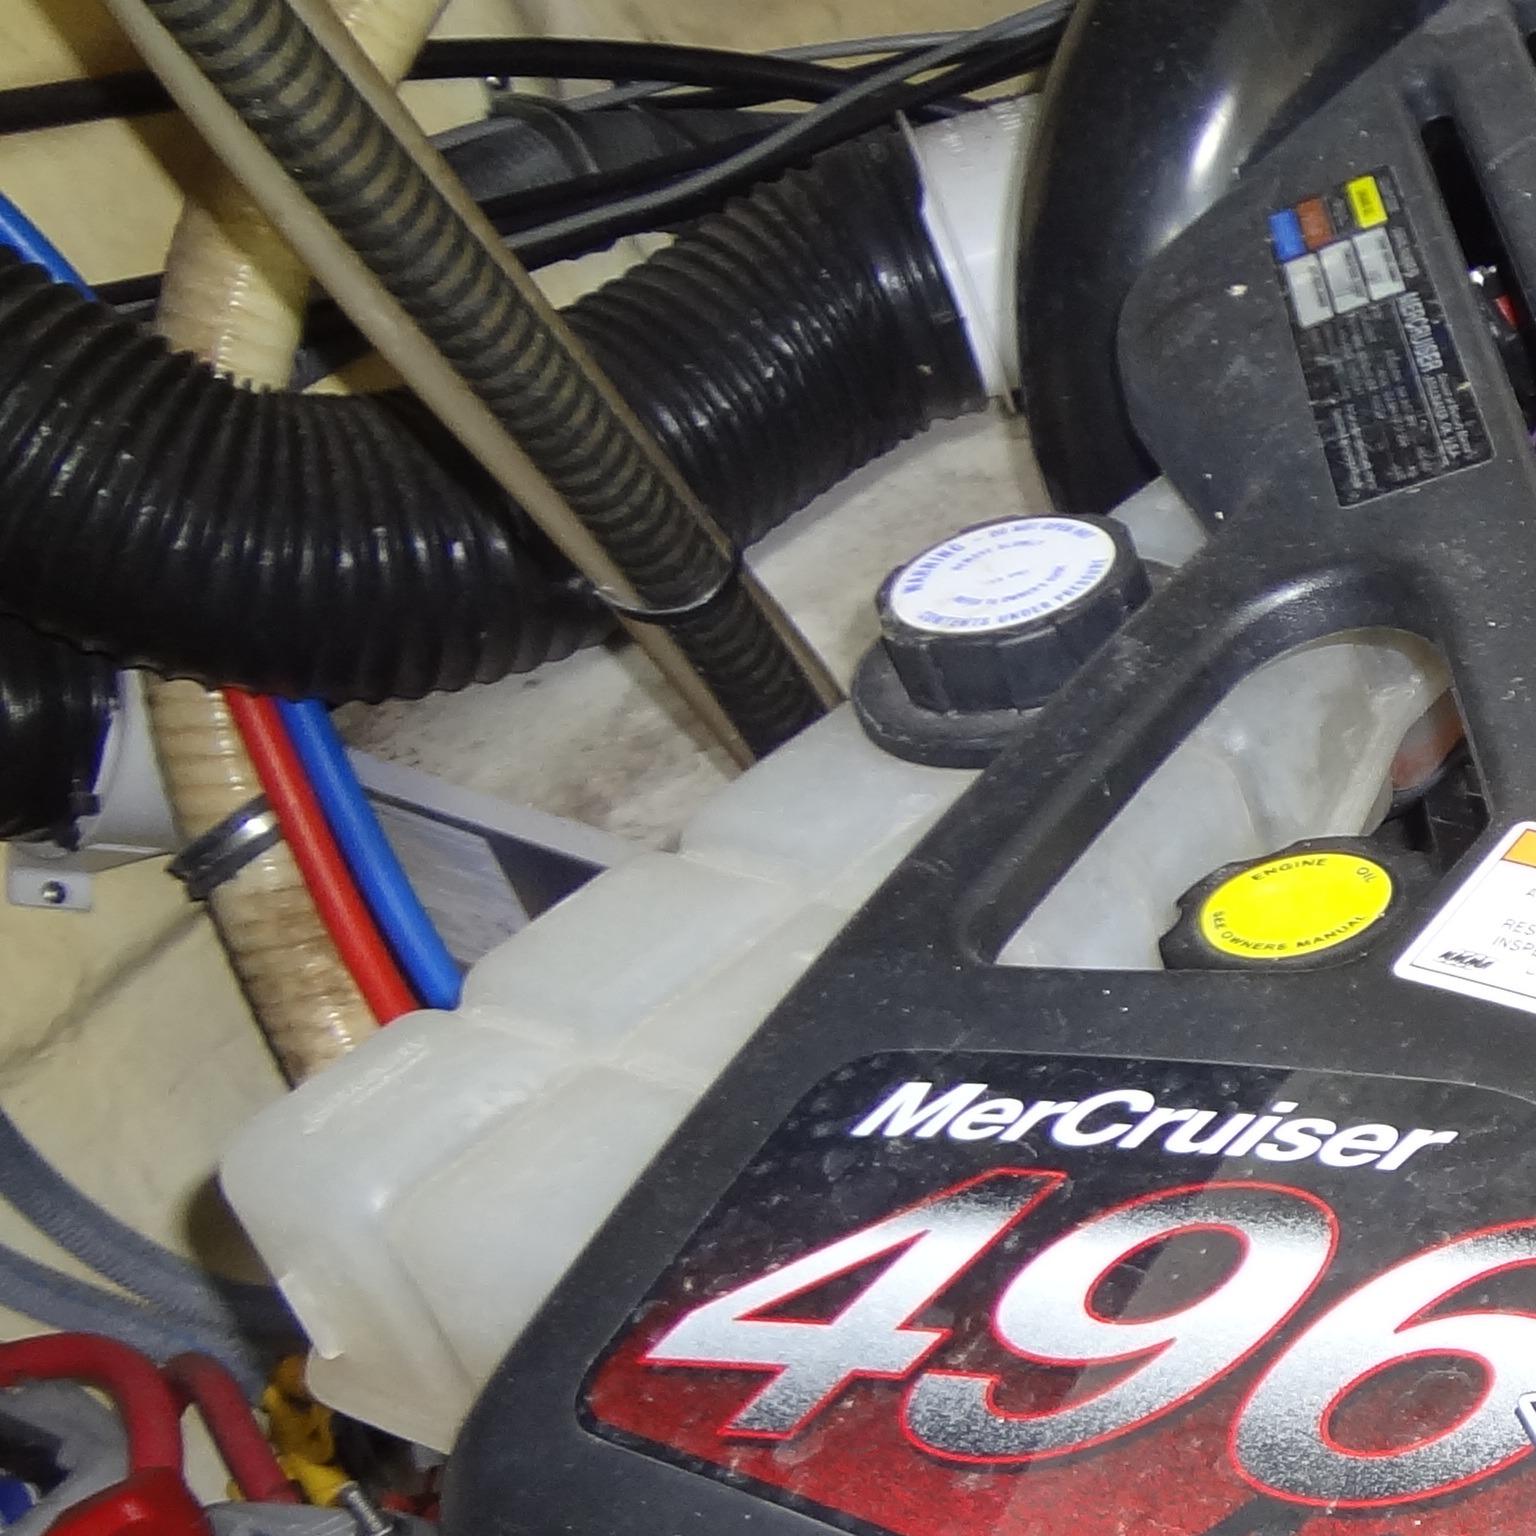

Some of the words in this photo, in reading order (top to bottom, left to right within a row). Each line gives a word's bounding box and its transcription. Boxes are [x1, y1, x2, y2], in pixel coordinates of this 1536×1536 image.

[1394, 288, 1444, 375] MERCRUISER
[903, 543, 966, 594] WARNING
[998, 601, 1052, 624] UNDER
[1251, 857, 1329, 881] ENGINE
[1356, 866, 1377, 883] OIL
[1212, 909, 1226, 930] SEE
[1220, 930, 1288, 952] OWNERS
[1295, 914, 1367, 949] MANUAL
[850, 1081, 1459, 1179] MerCruiser
